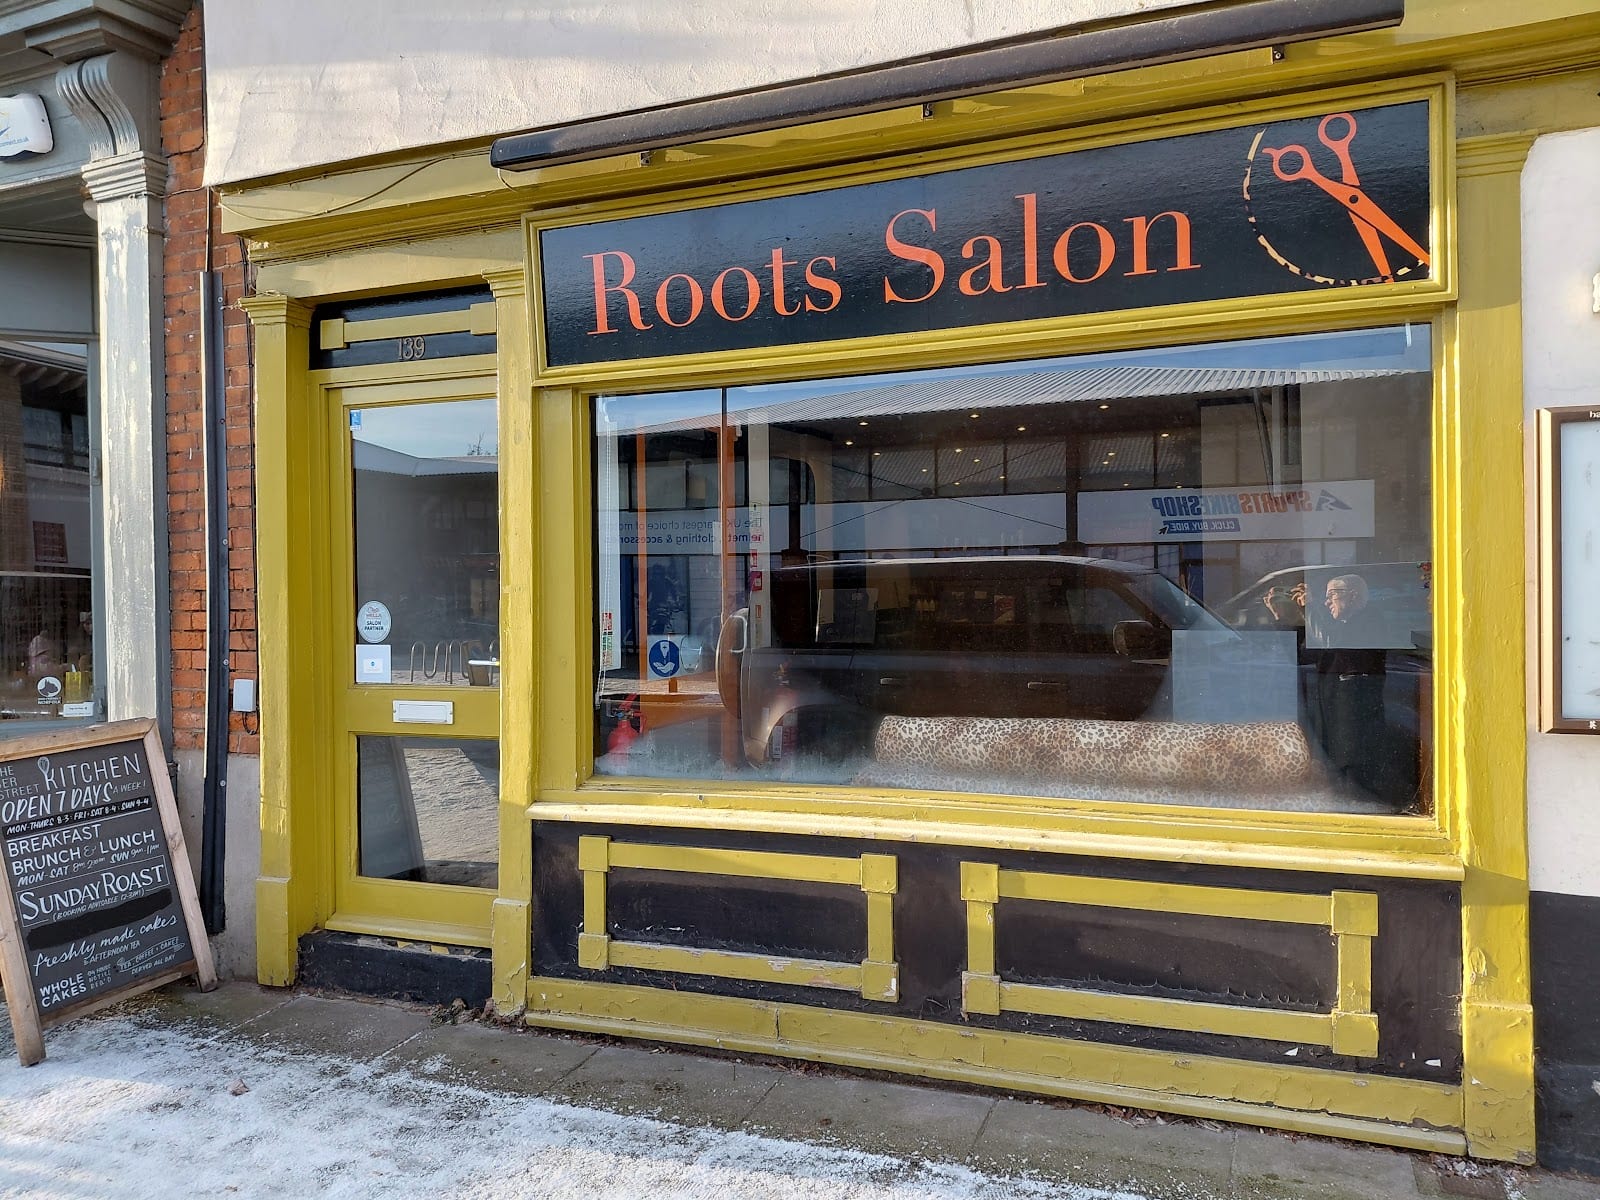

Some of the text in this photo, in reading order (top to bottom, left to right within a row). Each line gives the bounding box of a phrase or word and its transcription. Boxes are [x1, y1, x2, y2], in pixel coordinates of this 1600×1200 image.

[582, 192, 1202, 336] Roots Salon
[398, 336, 426, 360] 139
[0, 777, 17, 790] ER
[38, 753, 141, 791] KITCHEN
[2, 794, 51, 824] OPEN
[55, 790, 66, 812] 7
[71, 782, 114, 810] DAYS
[7, 824, 102, 858] BREAKFAST
[12, 829, 156, 875] BRUNCH & LUNCH
[18, 865, 70, 887] MON-SAT
[110, 850, 130, 864] SUN
[19, 864, 165, 921] SUNDAY ROAST
[33, 914, 178, 977] freshly made cakes
[89, 944, 129, 964] AFTERNOON
[39, 972, 83, 997] WHOLE
[41, 983, 87, 1008] CAKES
